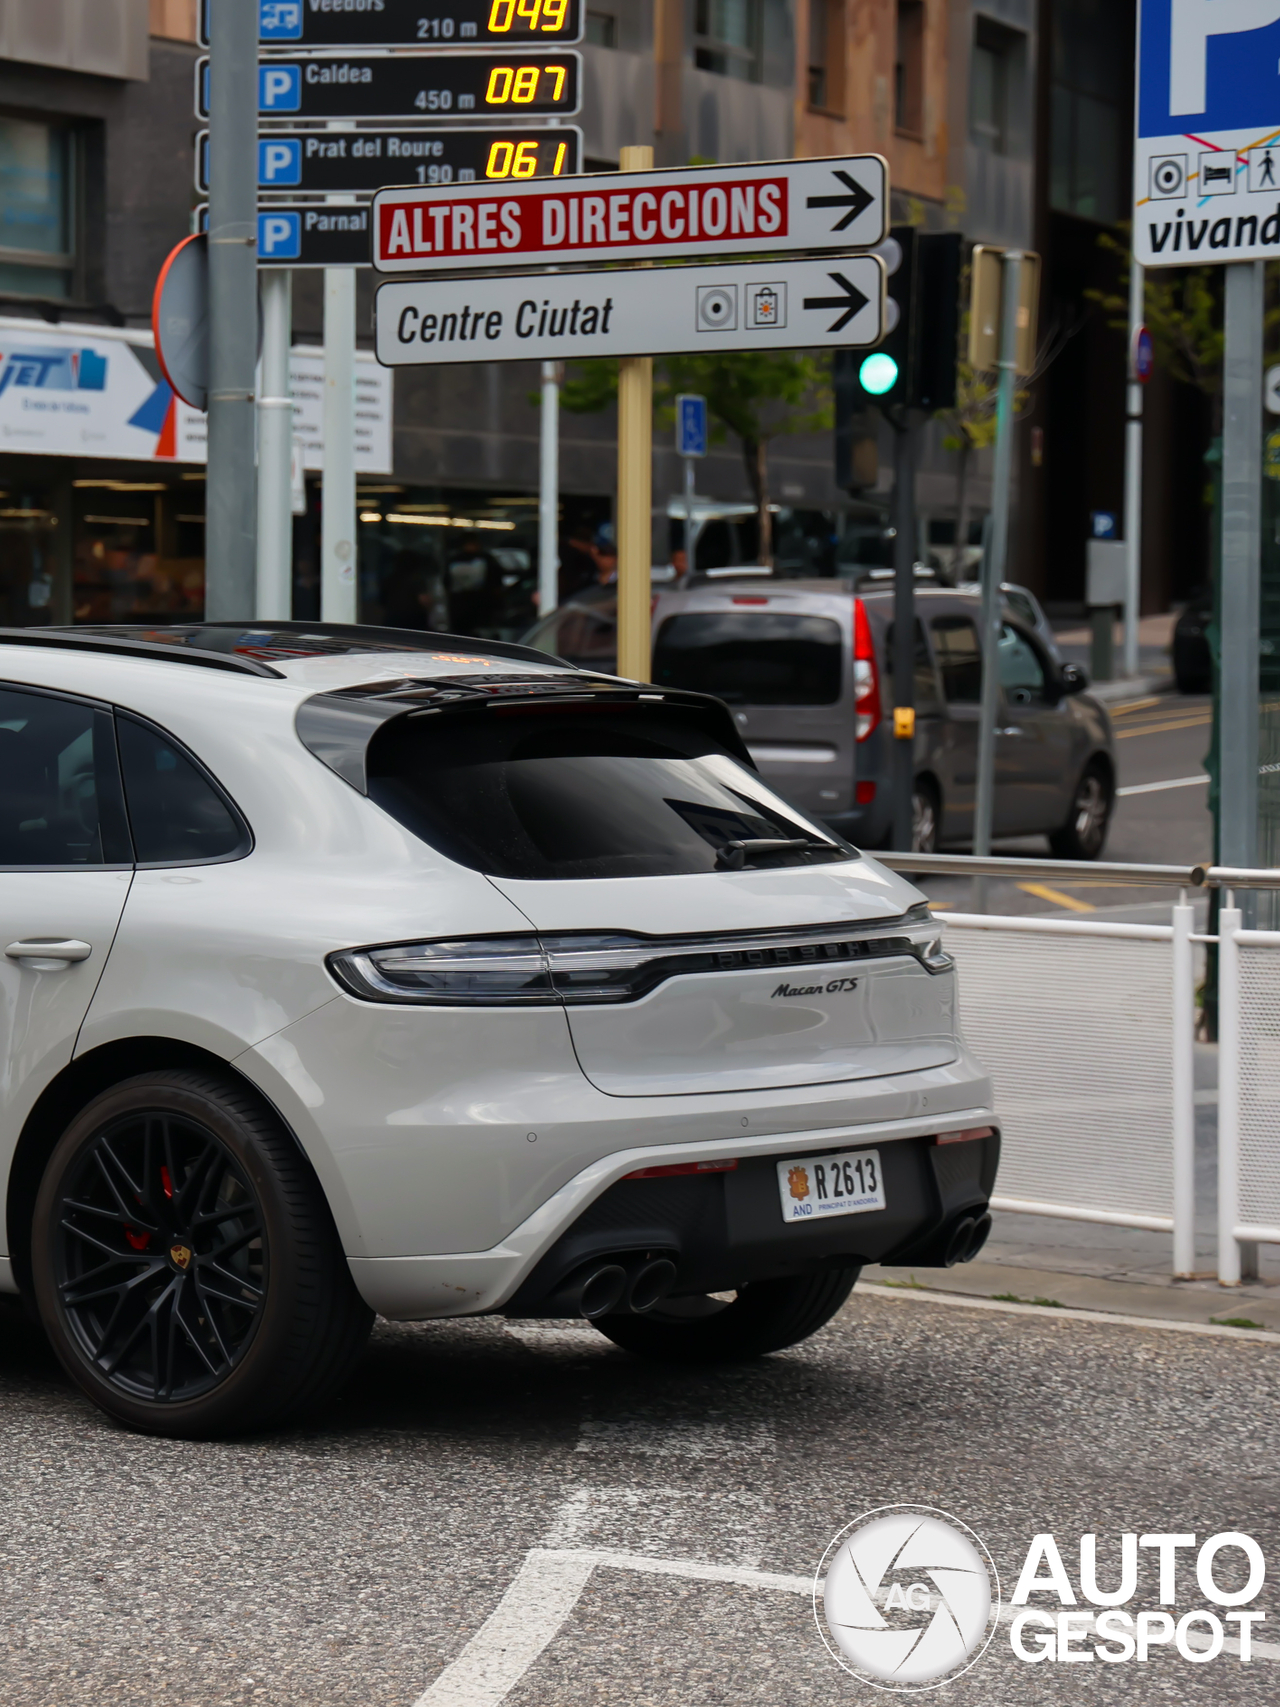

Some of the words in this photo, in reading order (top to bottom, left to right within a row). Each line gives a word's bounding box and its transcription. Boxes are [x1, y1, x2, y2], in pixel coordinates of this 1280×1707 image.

[488, 0, 568, 32] 049
[417, 19, 455, 38] 210
[460, 22, 477, 37] m
[306, 63, 372, 83] Caldea
[485, 66, 566, 104] 087
[414, 91, 452, 110] 450
[458, 94, 475, 109] m
[306, 138, 347, 158] Prat
[352, 138, 382, 157] del
[387, 137, 444, 157] Roure
[485, 141, 566, 179] 061
[416, 164, 453, 184] 190
[458, 168, 475, 182] m
[305, 210, 367, 231] Parnal
[388, 201, 521, 254] ALTRES
[542, 184, 781, 246] DIRECCIONS
[398, 305, 502, 344] Centre
[515, 299, 613, 339] Ciutat
[771, 983, 823, 999] Macan
[826, 977, 859, 994] GTS
[814, 1164, 828, 1200] R
[831, 1158, 877, 1198] 2613
[793, 1204, 812, 1217] AND
